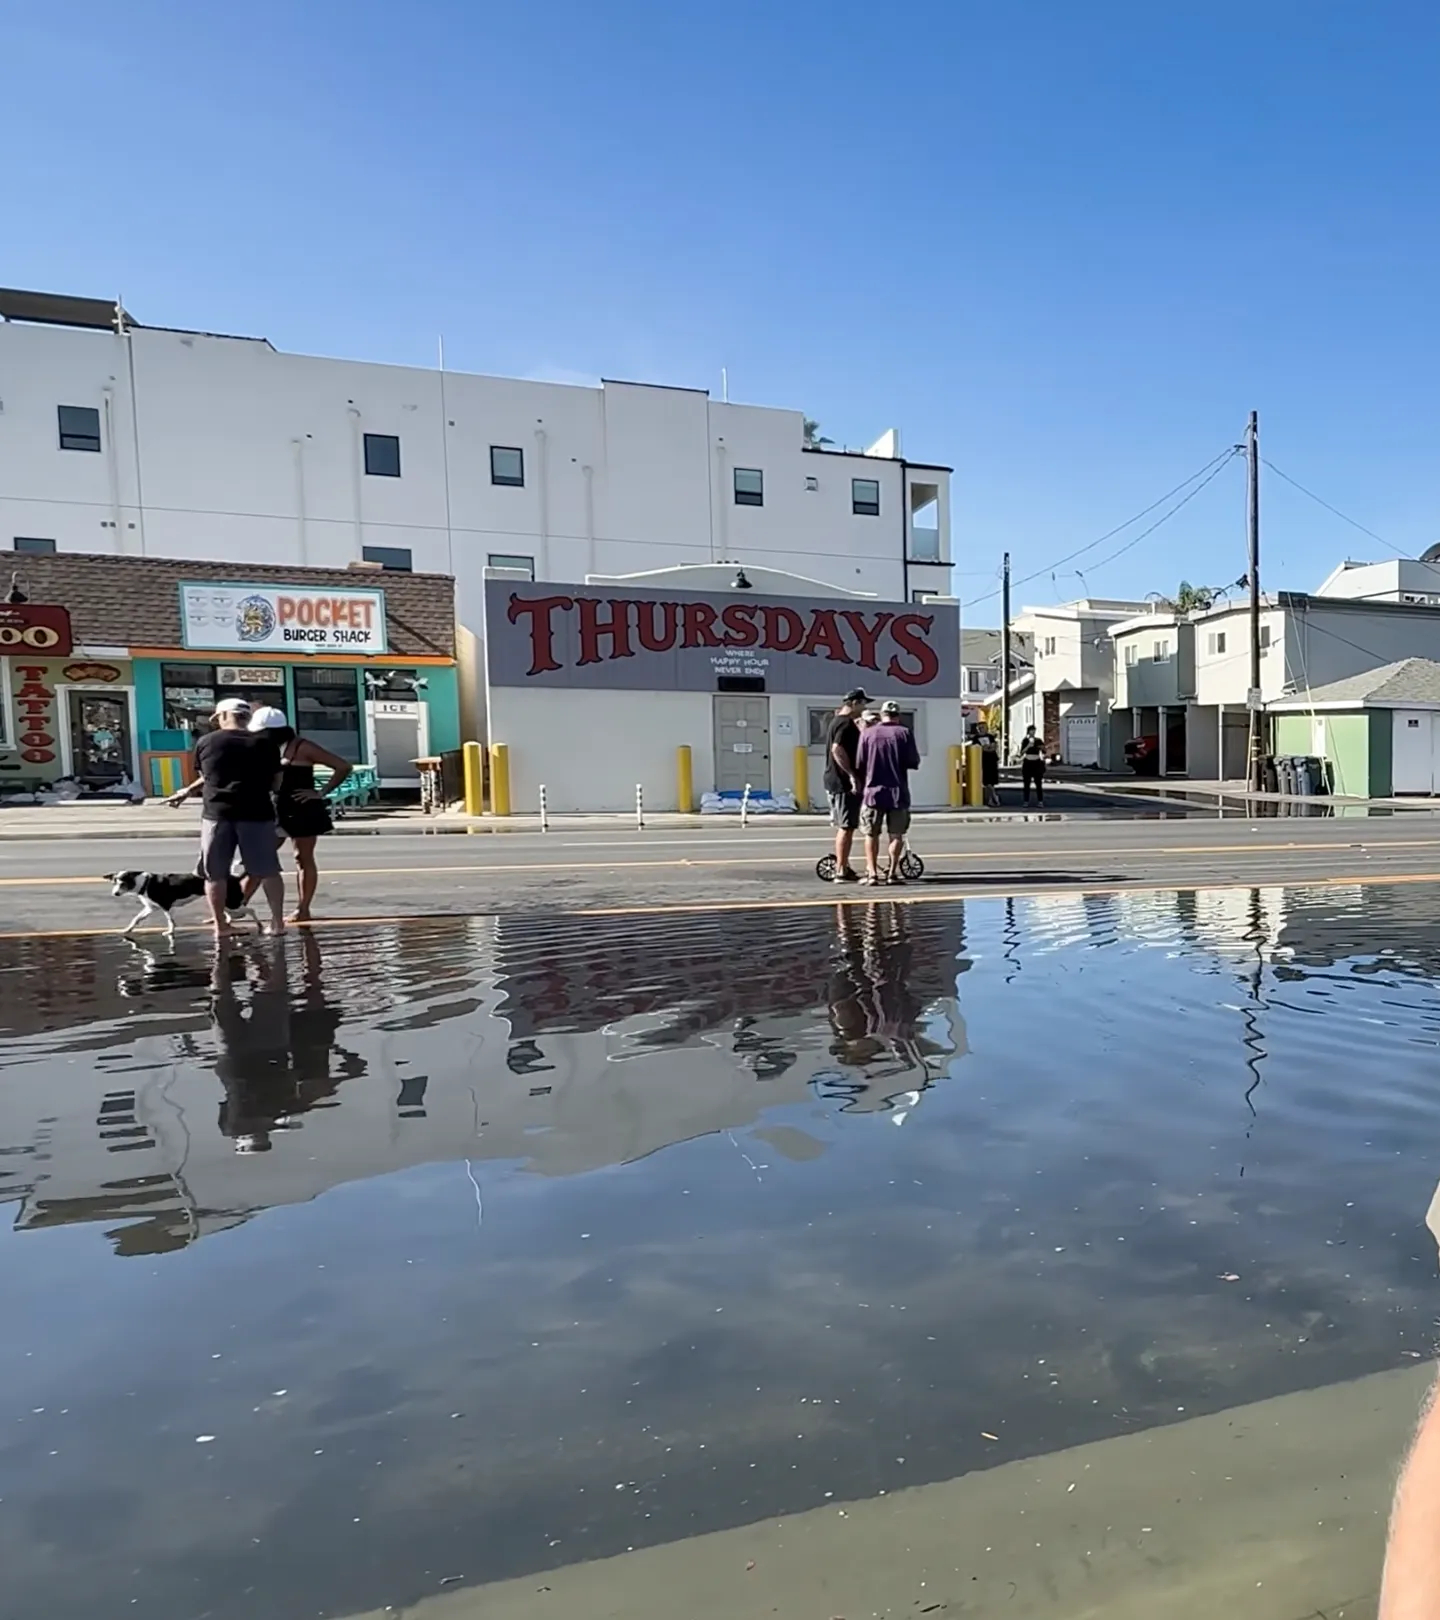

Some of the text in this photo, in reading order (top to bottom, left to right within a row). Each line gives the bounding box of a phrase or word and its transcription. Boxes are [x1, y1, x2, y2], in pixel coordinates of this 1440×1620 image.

[277, 596, 376, 629] POCKET
[283, 629, 371, 643] BURGER SHACK
[507, 592, 940, 686] THURSDAYS
[710, 657, 769, 666] HAPPY HOUR
[744, 667, 765, 675] ENDS
[13, 666, 55, 763] TATTOO
[383, 704, 408, 712] ICE
